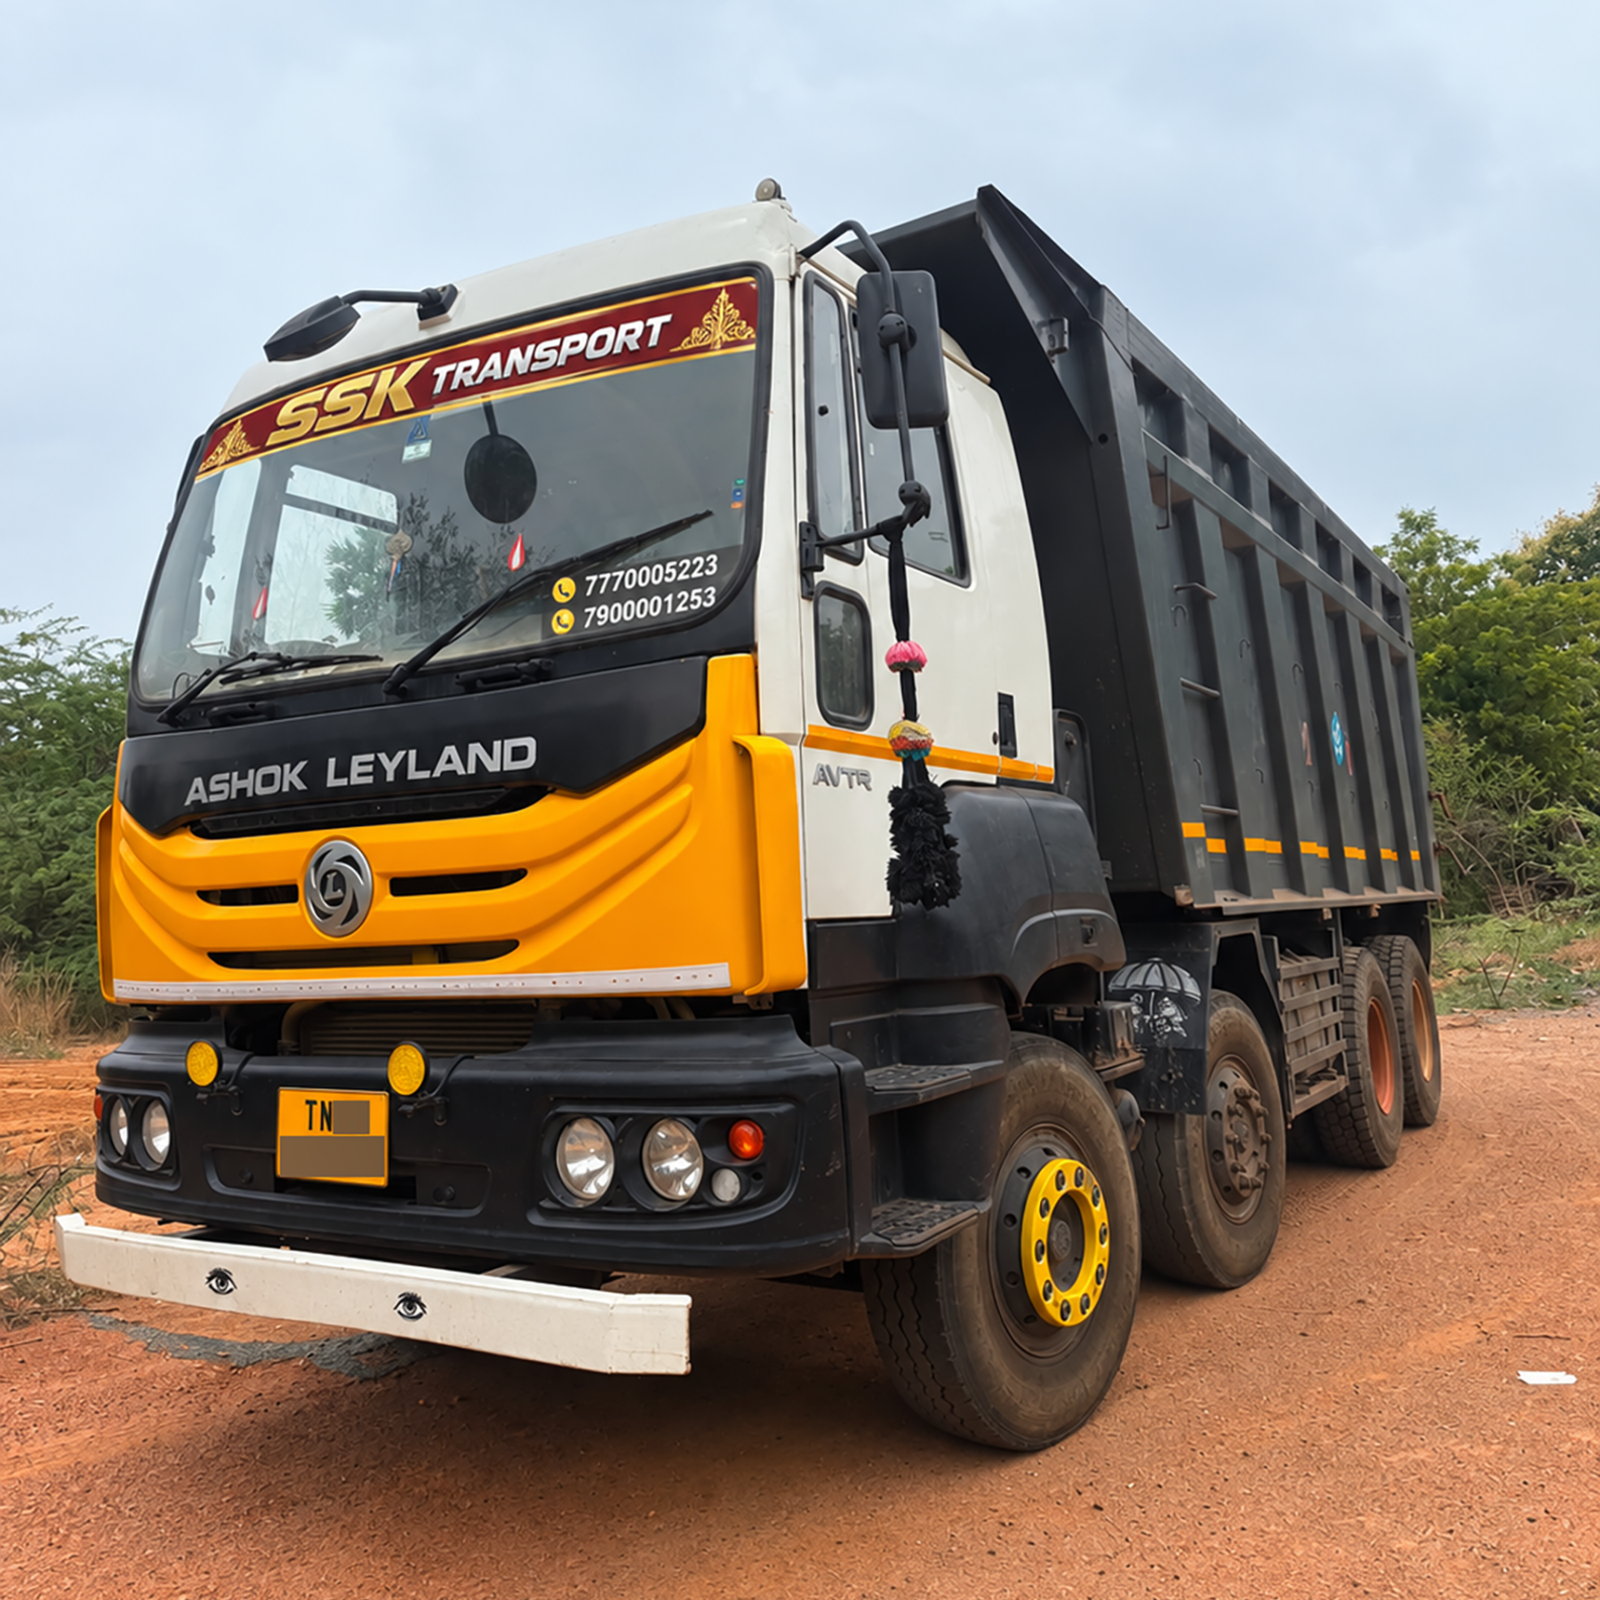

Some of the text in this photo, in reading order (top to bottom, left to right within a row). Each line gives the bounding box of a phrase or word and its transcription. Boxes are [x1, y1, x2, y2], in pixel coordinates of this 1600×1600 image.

[265, 314, 673, 447] SSK TRANSPORT
[585, 554, 718, 597] 7770005223
[584, 586, 717, 629] 7900001253
[184, 736, 537, 807] ASHOK LEYLAND
[812, 763, 872, 791] AVTR
[305, 1099, 332, 1132] TN
